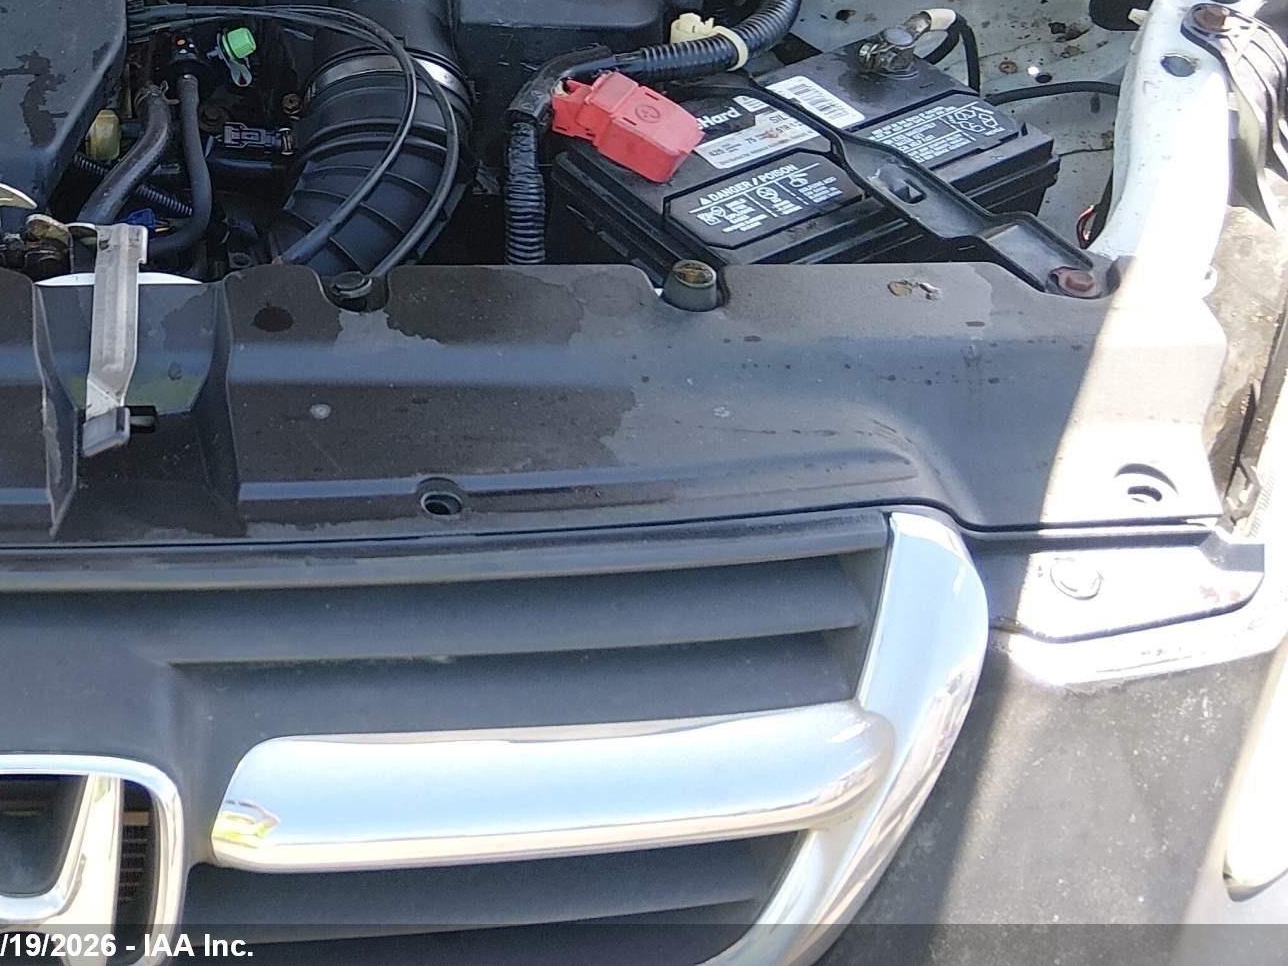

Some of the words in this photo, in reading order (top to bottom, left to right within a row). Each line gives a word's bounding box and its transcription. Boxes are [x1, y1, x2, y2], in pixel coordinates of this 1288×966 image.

[769, 114, 790, 124] SIL
[707, 180, 754, 202] DANGER
[757, 164, 799, 183] POISON
